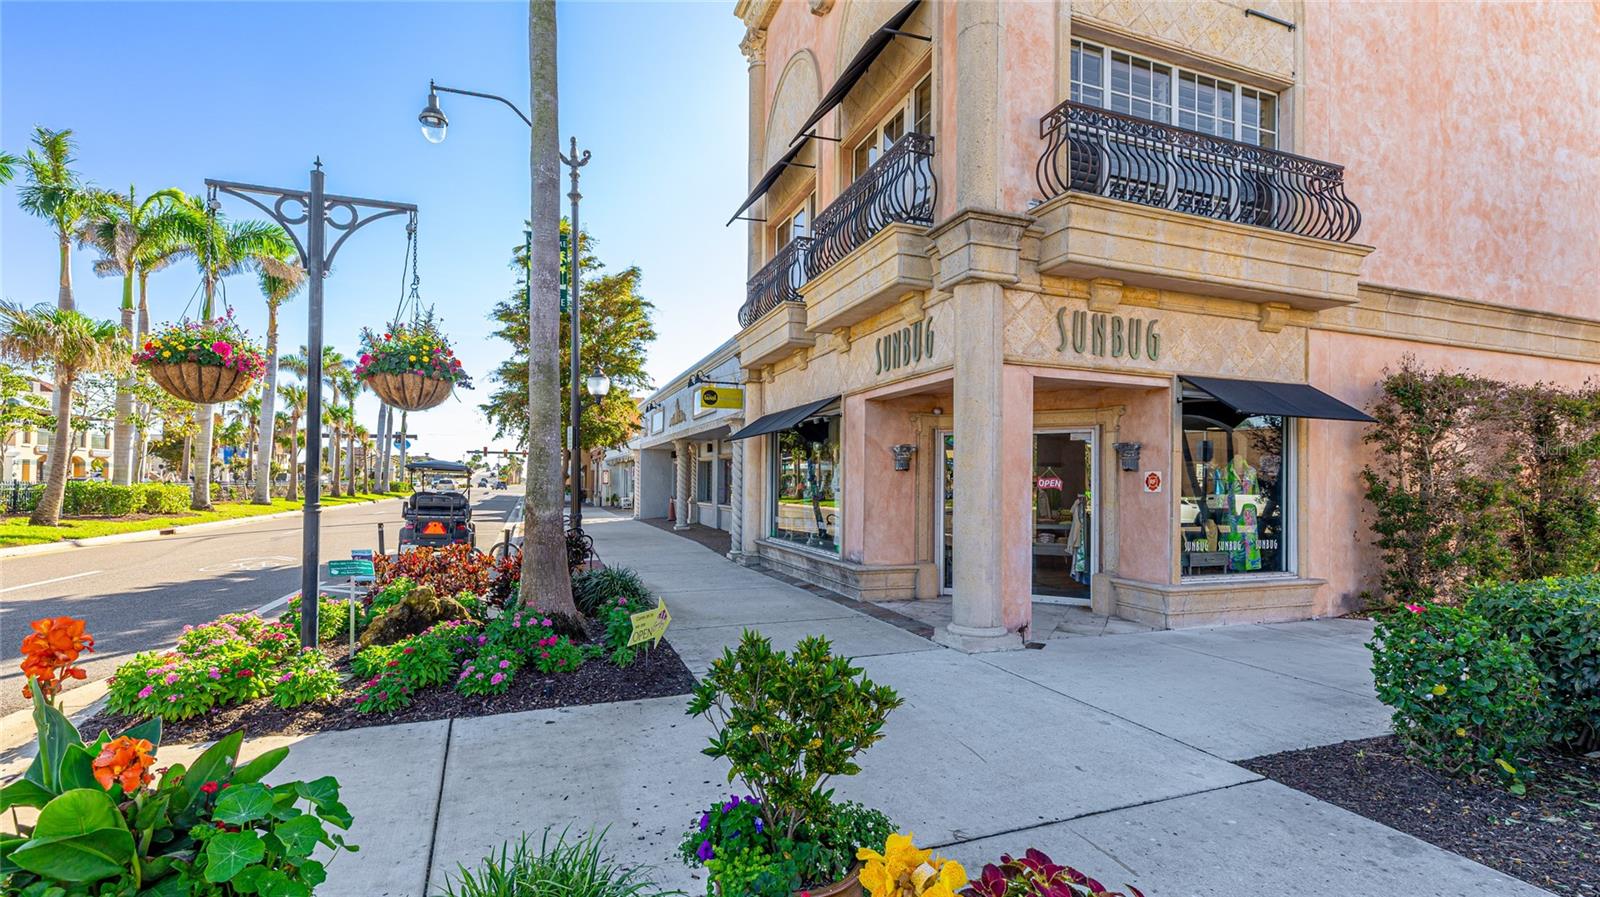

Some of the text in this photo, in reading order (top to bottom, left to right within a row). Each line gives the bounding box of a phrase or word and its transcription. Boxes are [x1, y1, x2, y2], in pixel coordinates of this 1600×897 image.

[875, 316, 934, 375] SUNBUG
[1057, 306, 1161, 361] SUNBUG
[1038, 479, 1062, 488] OPEN
[1184, 539, 1278, 552] SUNBUG SUNBUG SUNBUG
